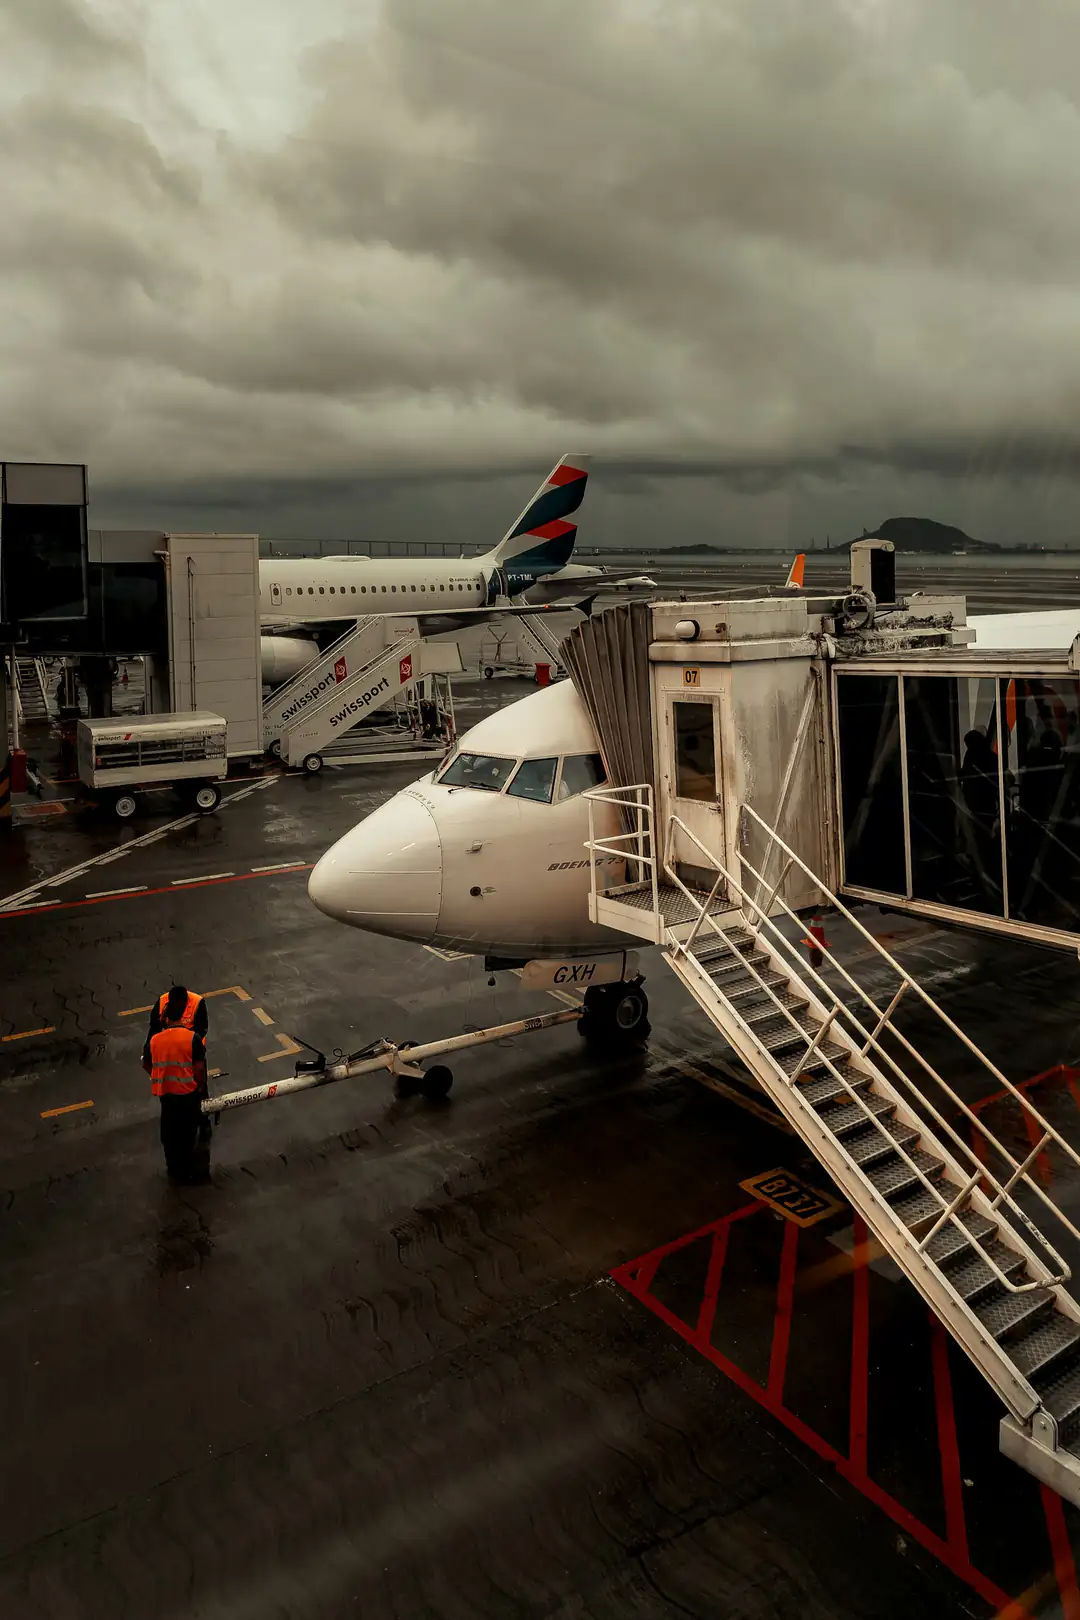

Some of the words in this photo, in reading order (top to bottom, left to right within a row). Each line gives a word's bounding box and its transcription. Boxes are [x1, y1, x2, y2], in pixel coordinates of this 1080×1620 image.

[685, 670, 698, 683] 07
[281, 672, 336, 721] swissport
[329, 677, 390, 727] swissport
[547, 858, 604, 871] BOEING
[607, 856, 626, 865] 73
[553, 963, 597, 984] GXH
[759, 1178, 825, 1214] B737
